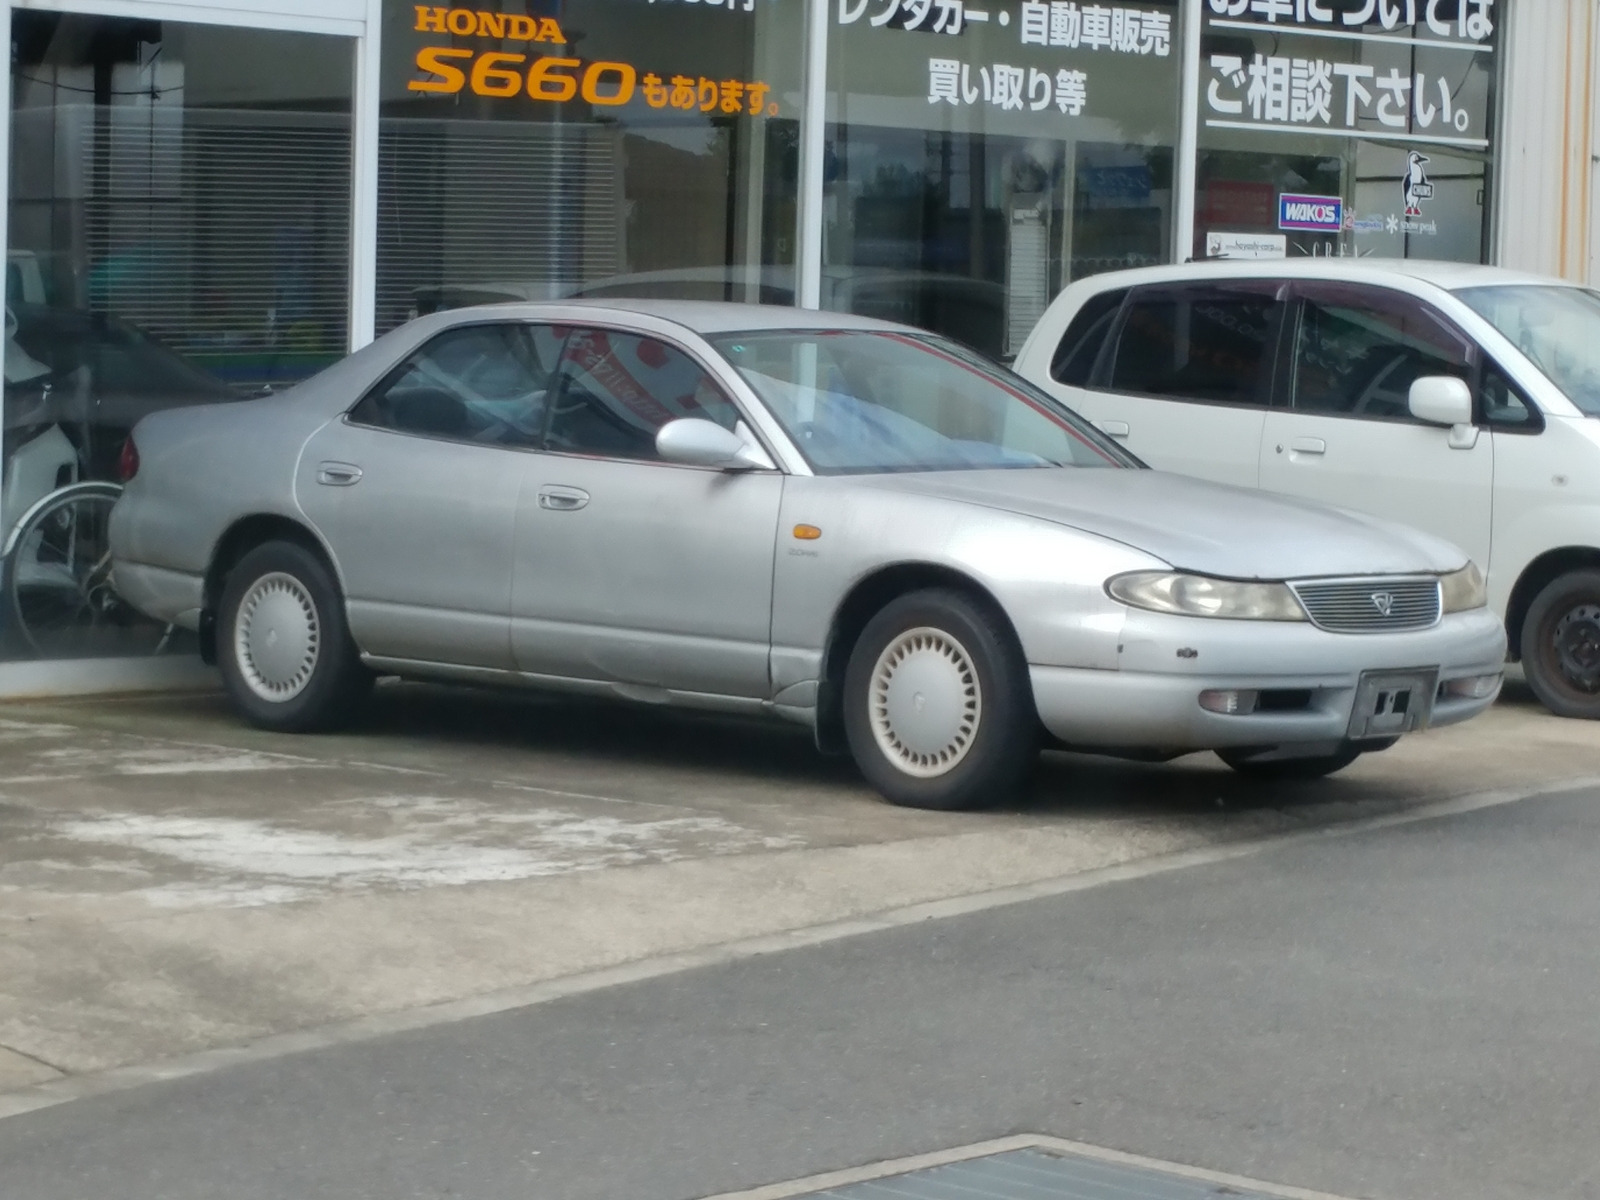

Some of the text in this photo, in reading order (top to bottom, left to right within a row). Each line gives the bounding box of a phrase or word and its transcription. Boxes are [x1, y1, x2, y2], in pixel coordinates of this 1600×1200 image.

[414, 5, 567, 44] HONDA
[1208, 0, 1494, 40] ついては
[928, 58, 1088, 117] 買い取り等
[1207, 53, 1470, 132] ご相談下さい。
